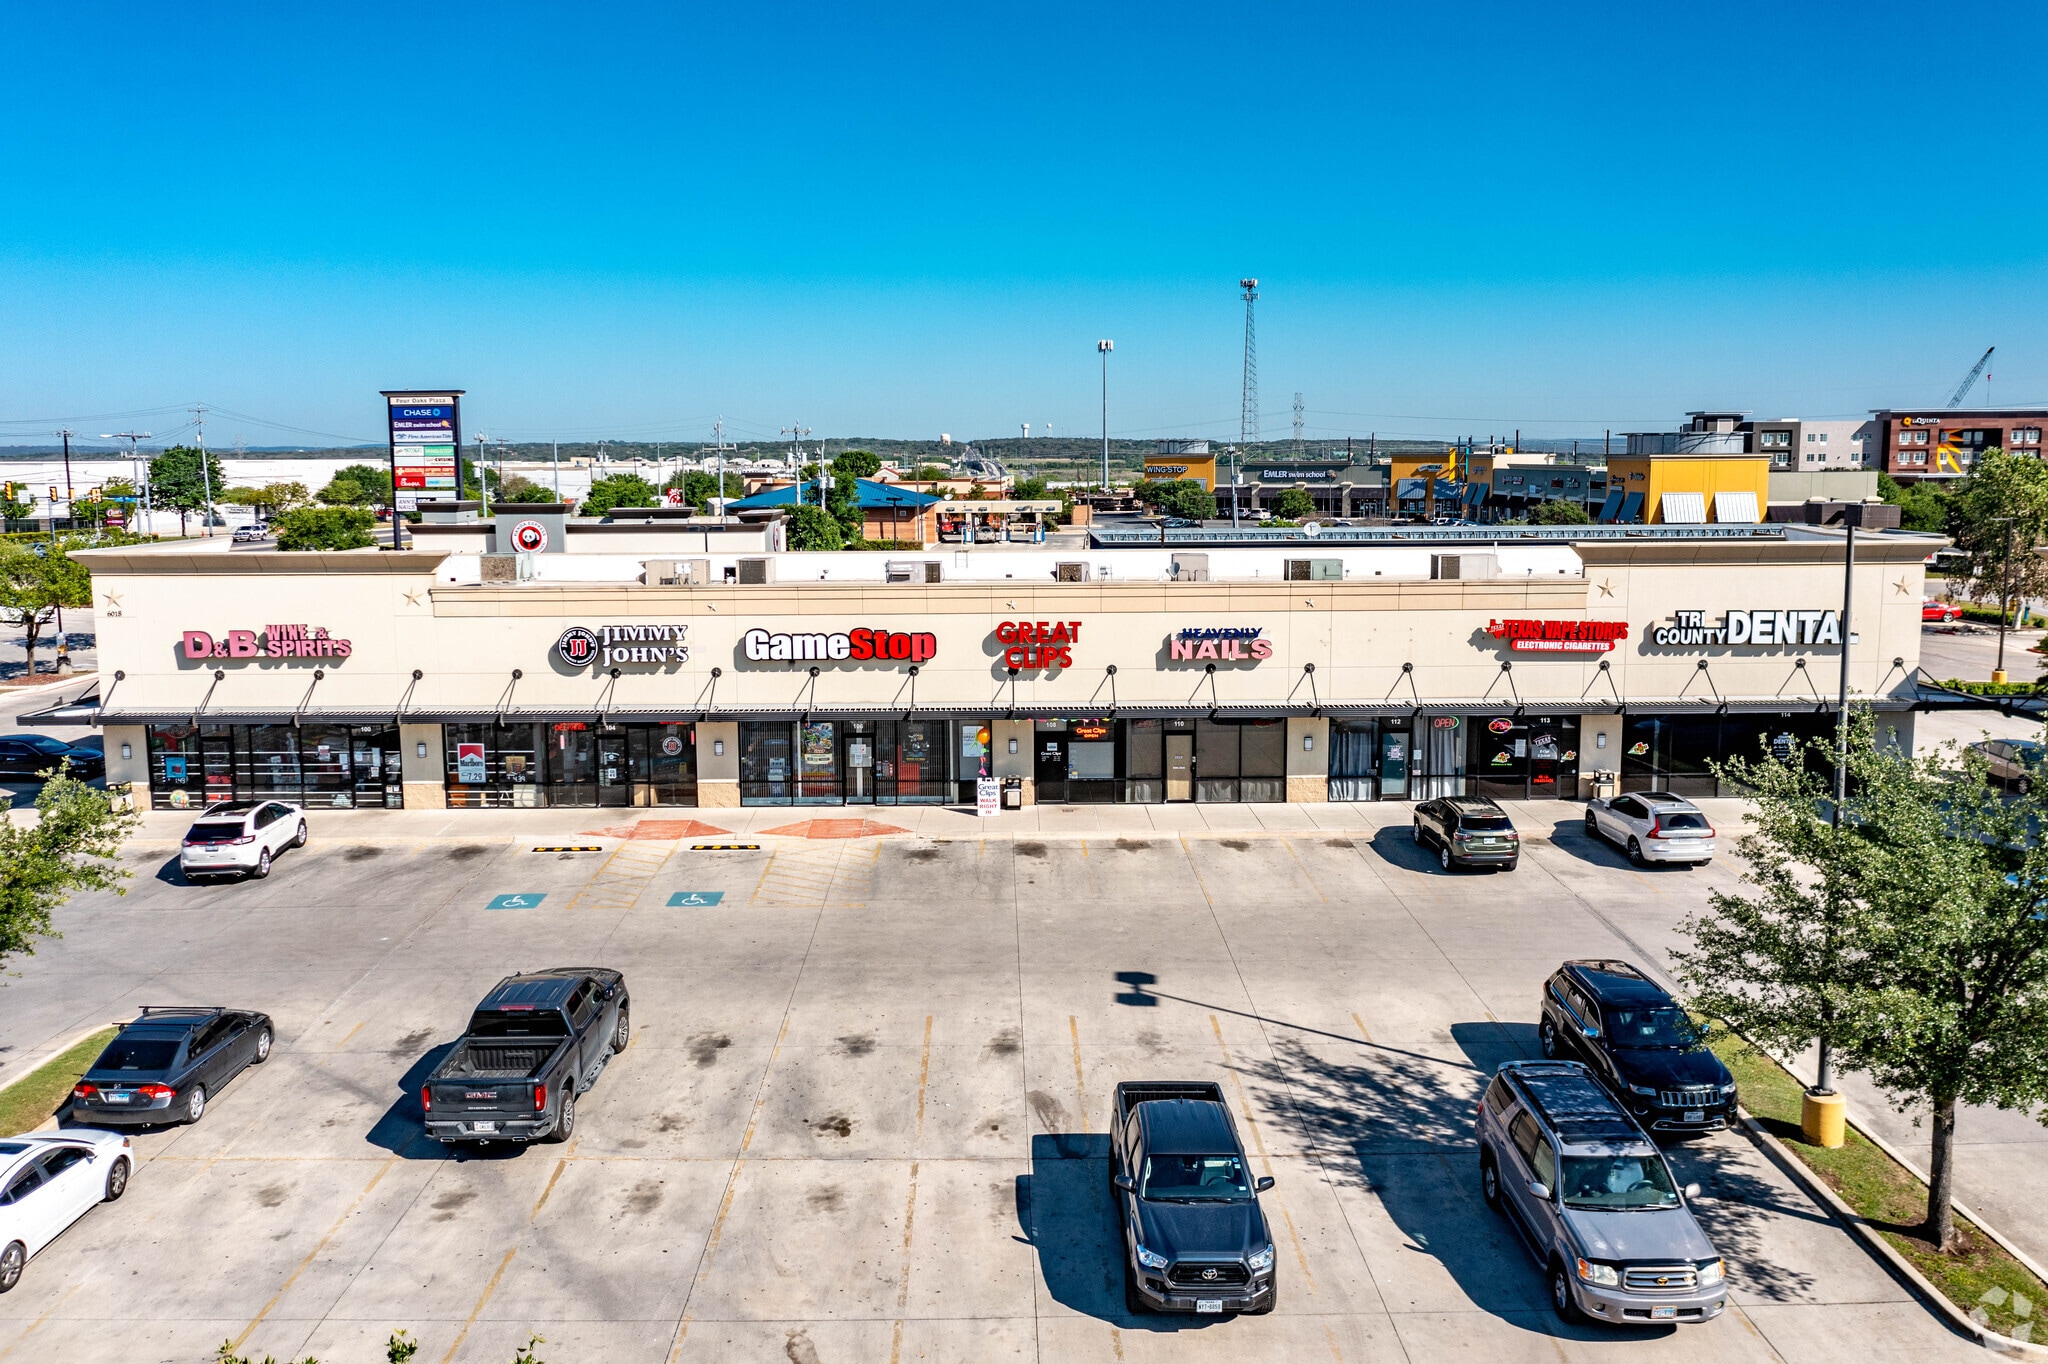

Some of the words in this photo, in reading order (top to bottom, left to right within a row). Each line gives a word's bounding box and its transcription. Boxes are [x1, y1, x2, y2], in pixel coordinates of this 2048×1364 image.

[403, 409, 432, 417] CHASE
[393, 421, 413, 429] EMLER
[1263, 469, 1288, 478] EMLER
[1288, 470, 1305, 478] swim
[1305, 470, 1326, 478] school
[1676, 610, 1706, 628] TRI
[265, 623, 308, 641] WINE
[317, 626, 329, 640] &
[602, 624, 688, 646] JIMMY
[995, 621, 1082, 645] GREAT
[1181, 627, 1263, 639] HEAVENLY
[1502, 619, 1544, 639] TEXAS
[1543, 620, 1578, 639] VAPE
[1577, 621, 1629, 640] STORES
[1654, 627, 1728, 646] COUNTY
[182, 629, 260, 659] D&B
[266, 639, 353, 658] SPIRITS
[569, 638, 588, 657] JJ
[744, 627, 937, 662] GameStop
[1170, 638, 1273, 660] NAILS
[1516, 640, 1563, 650] ELECTRONIC
[1563, 641, 1610, 651] CIGARETTES
[602, 646, 690, 667] JOHN'S
[1005, 645, 1073, 669] CLIPS
[1092, 727, 1107, 735] Clips
[1434, 717, 1455, 728] OPEN
[460, 759, 484, 767] Marlboro
[467, 772, 483, 781] 7.29
[978, 789, 997, 797] Clips
[465, 1091, 497, 1099] GMC
